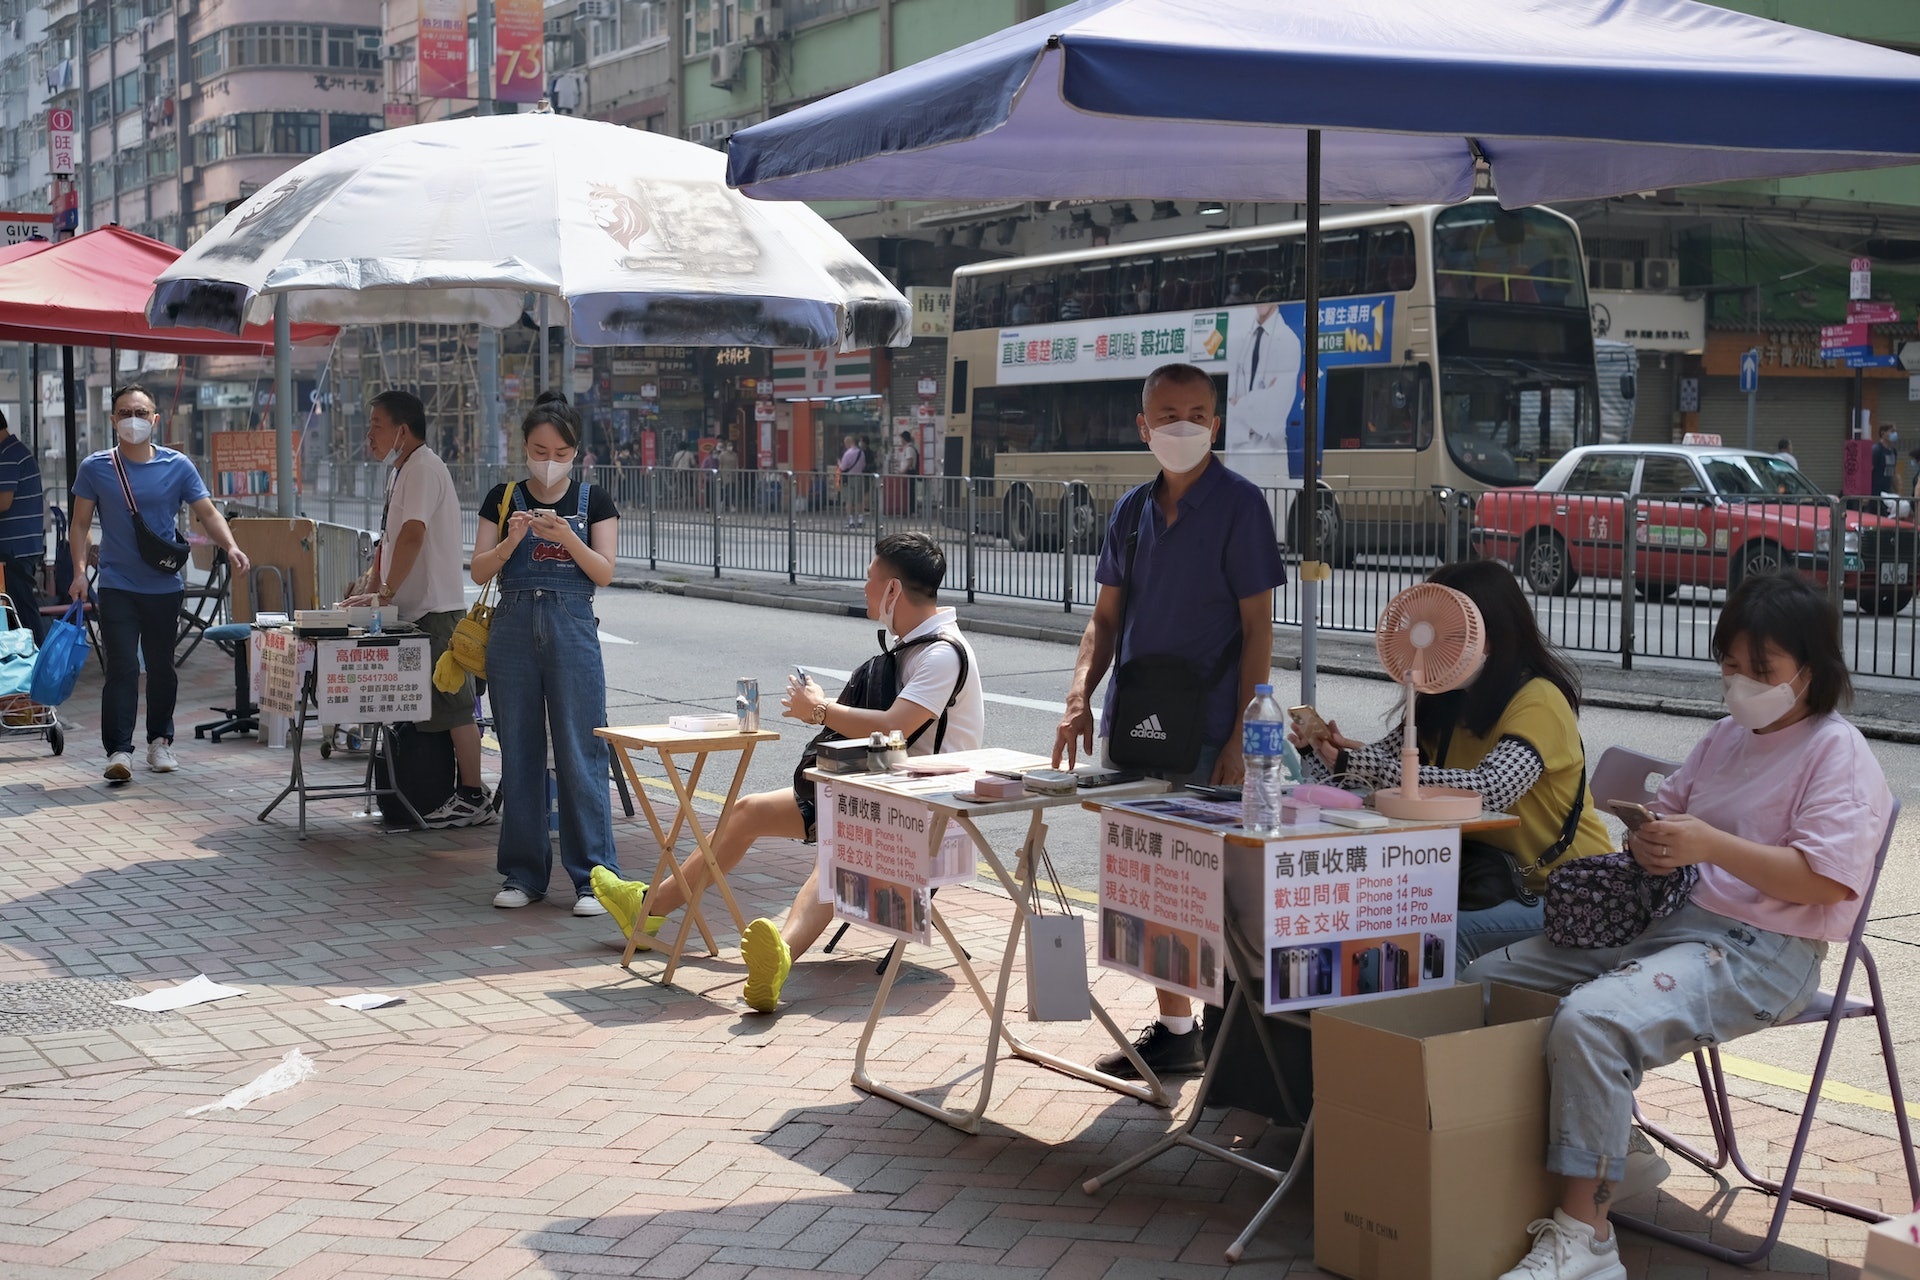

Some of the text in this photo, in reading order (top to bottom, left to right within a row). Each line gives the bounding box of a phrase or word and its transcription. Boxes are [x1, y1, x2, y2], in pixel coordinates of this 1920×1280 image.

[497, 44, 541, 85] 73
[55, 135, 71, 169] 旺角
[6, 225, 39, 237] GIVE
[1304, 305, 1370, 326] 本醫生選用
[1002, 328, 1185, 364] 直達痛楚根源 一痛即貼 慕拉適
[1692, 435, 1719, 445] TAXI
[336, 648, 390, 662] 高價收機
[327, 673, 399, 684] 張生 55417308
[1130, 729, 1167, 740] adidas
[838, 793, 881, 824] 高價收購
[888, 807, 924, 833] iPhone
[837, 821, 873, 847] 歡迎問價
[875, 828, 903, 843] iPhone 14
[837, 844, 873, 869] 現金交收
[875, 839, 916, 859] iPhone 14 Plus
[1107, 821, 1219, 871] 高價收購 iPhone
[875, 852, 915, 870] iPhone 14 Pro
[1106, 854, 1151, 885] 歡迎問價
[1275, 845, 1451, 879] 高價收購 iPhone
[875, 864, 927, 885] iPhone 14 Pro Max
[1155, 863, 1189, 882] iPhone 14
[1356, 874, 1408, 889] iPhone 14
[1105, 880, 1150, 911] 現金交收
[1154, 877, 1207, 901] iPhone 14 Plus
[1274, 883, 1350, 910] 歡迎問價
[1356, 886, 1433, 903] iPhone 14 Plus
[1154, 891, 1204, 914] iPhone 14 Pro
[1356, 900, 1428, 918] iPhone 14 Pro
[1154, 904, 1220, 933] iPhone 14 Pro Max
[1274, 910, 1350, 937] 現金交收
[1356, 912, 1453, 932] iPhone 14 Pro Max
